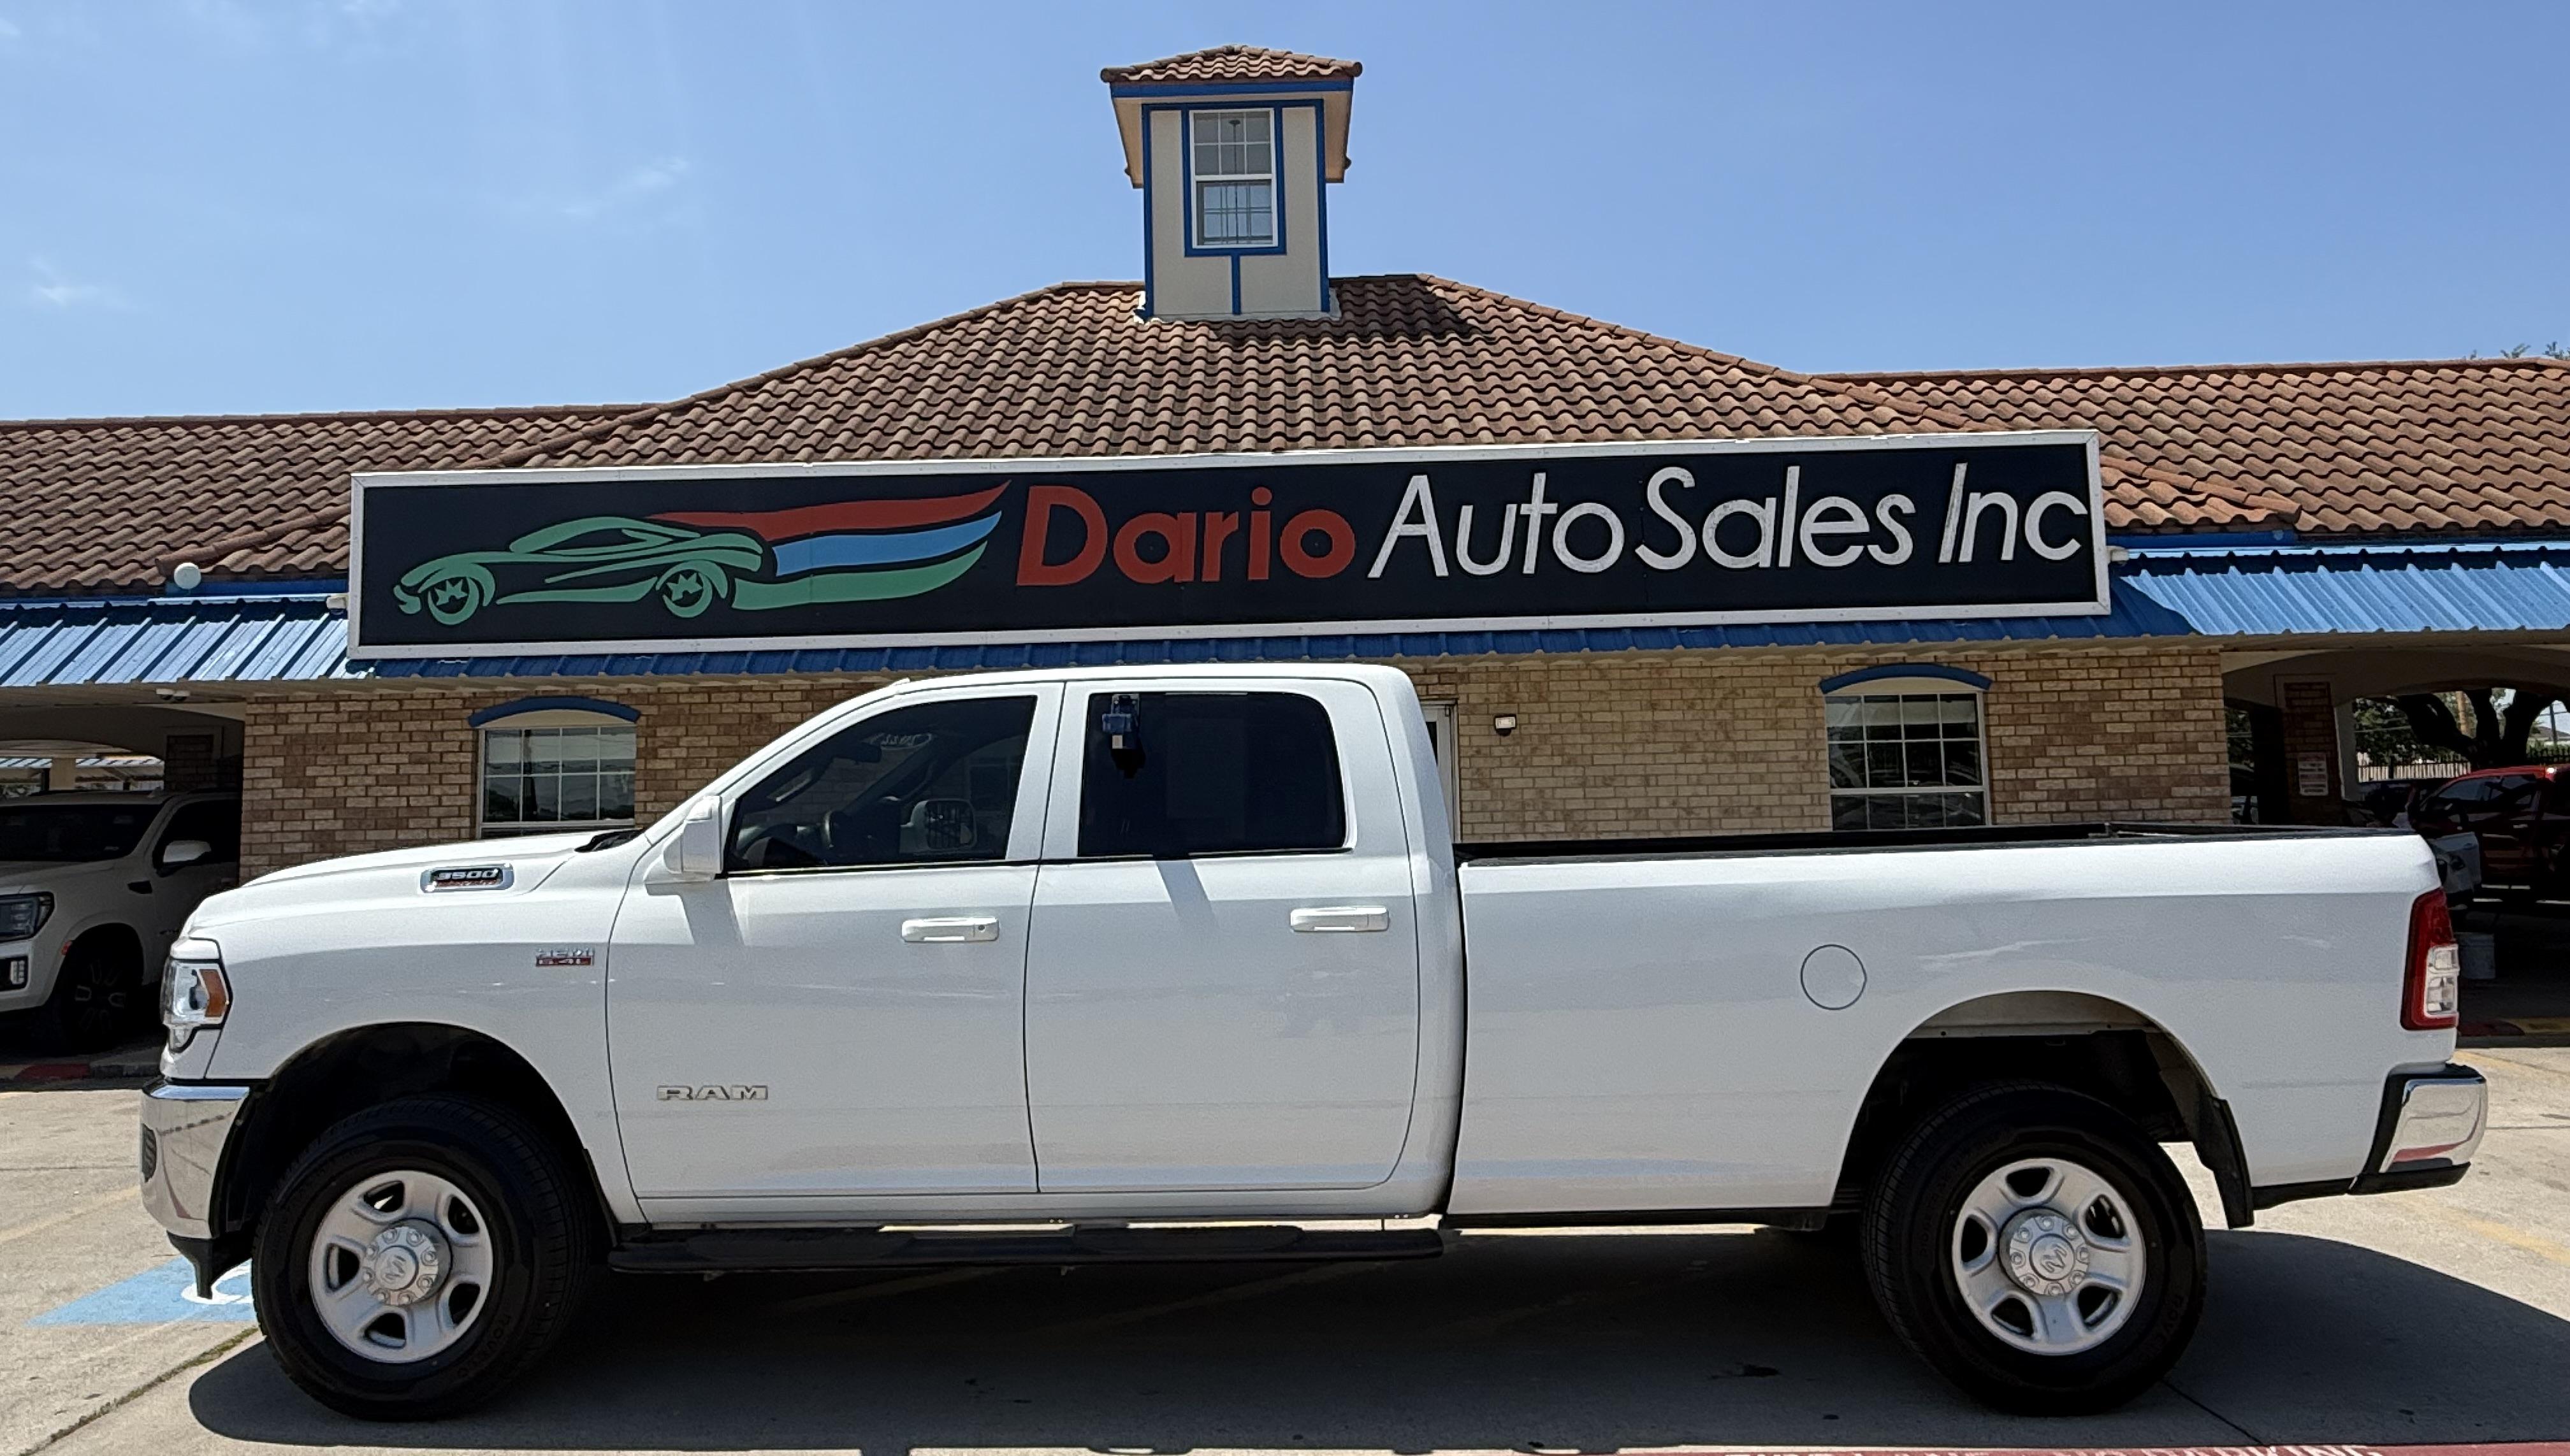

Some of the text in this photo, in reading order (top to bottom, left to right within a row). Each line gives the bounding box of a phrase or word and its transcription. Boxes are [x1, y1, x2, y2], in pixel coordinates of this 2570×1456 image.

[1017, 463, 2087, 586] Dario Auto Sales Inc
[657, 1085, 769, 1100] RAM
